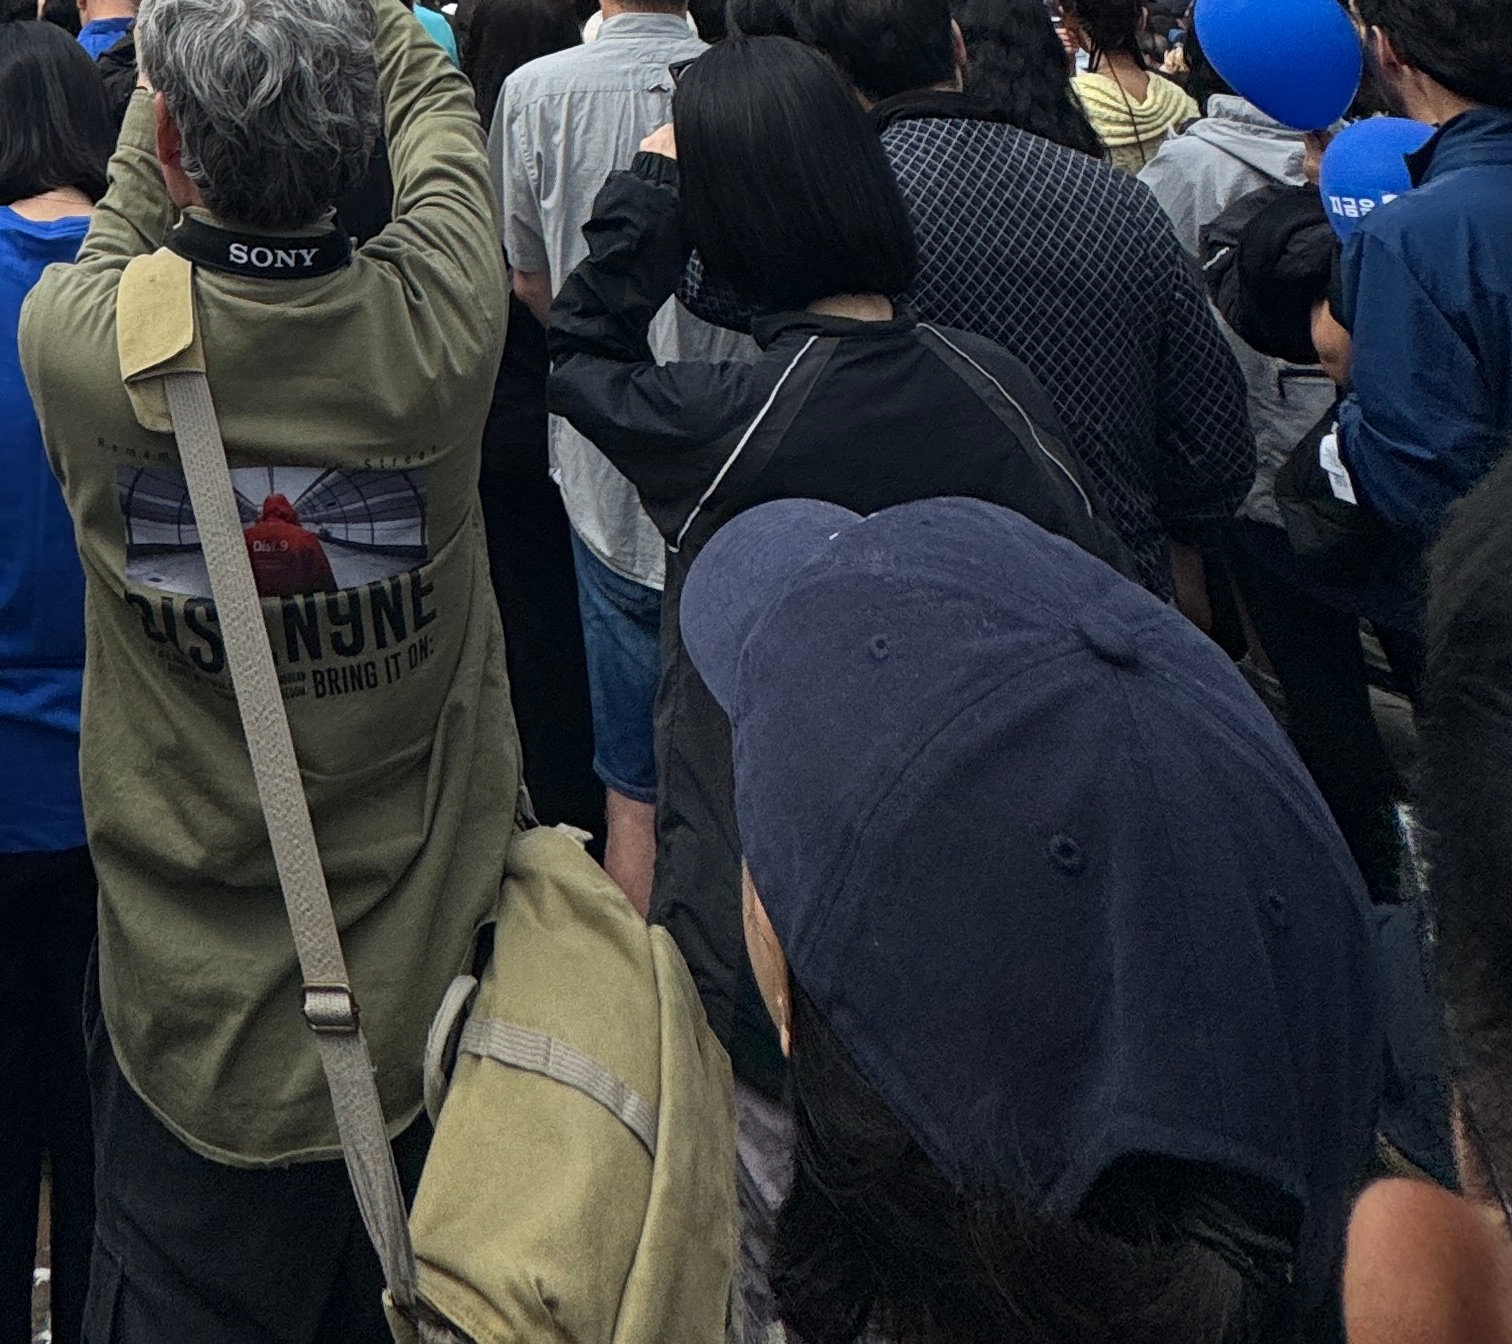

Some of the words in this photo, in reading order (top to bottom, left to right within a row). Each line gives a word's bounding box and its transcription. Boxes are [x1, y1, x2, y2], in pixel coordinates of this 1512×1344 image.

[229, 243, 319, 268] SONY
[312, 661, 378, 698] BRING
[385, 653, 402, 684] IT
